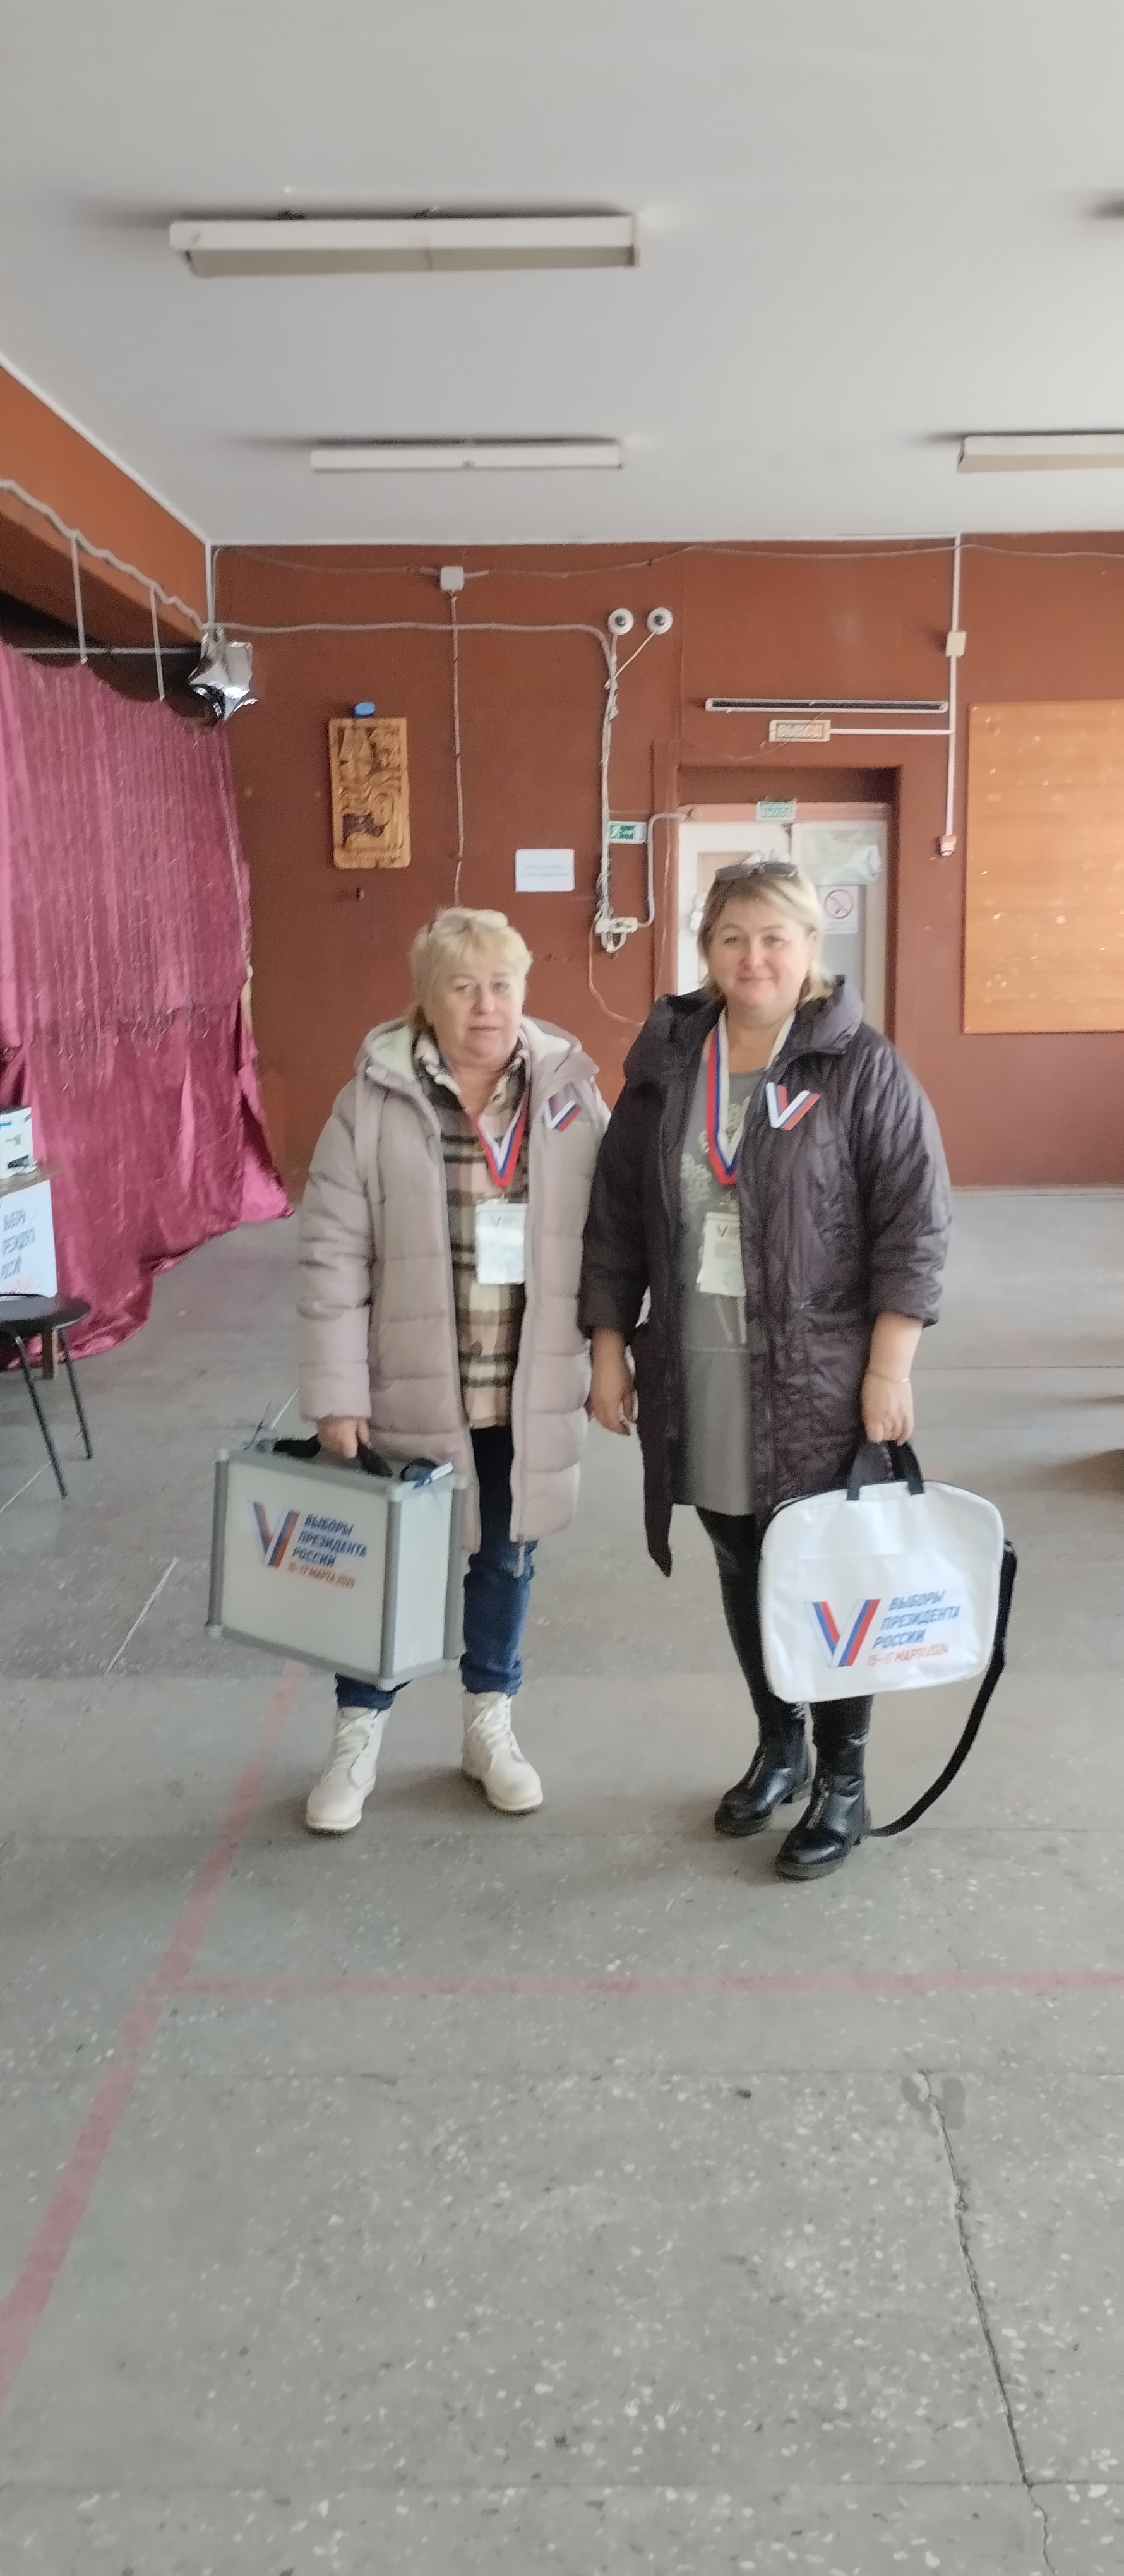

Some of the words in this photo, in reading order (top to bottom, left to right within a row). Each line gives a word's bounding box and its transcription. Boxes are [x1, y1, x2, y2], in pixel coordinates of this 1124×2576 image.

[304, 1513, 354, 1537] ВЫБОРЫ
[297, 1530, 368, 1558] ПРЕЗИДЕНТА
[292, 1546, 337, 1568] РОССИИ
[888, 1589, 947, 1611] ВЫБОРЫ
[880, 1605, 961, 1630] ПРЕЗИДЕНТА
[873, 1629, 926, 1649] РОССИИ
